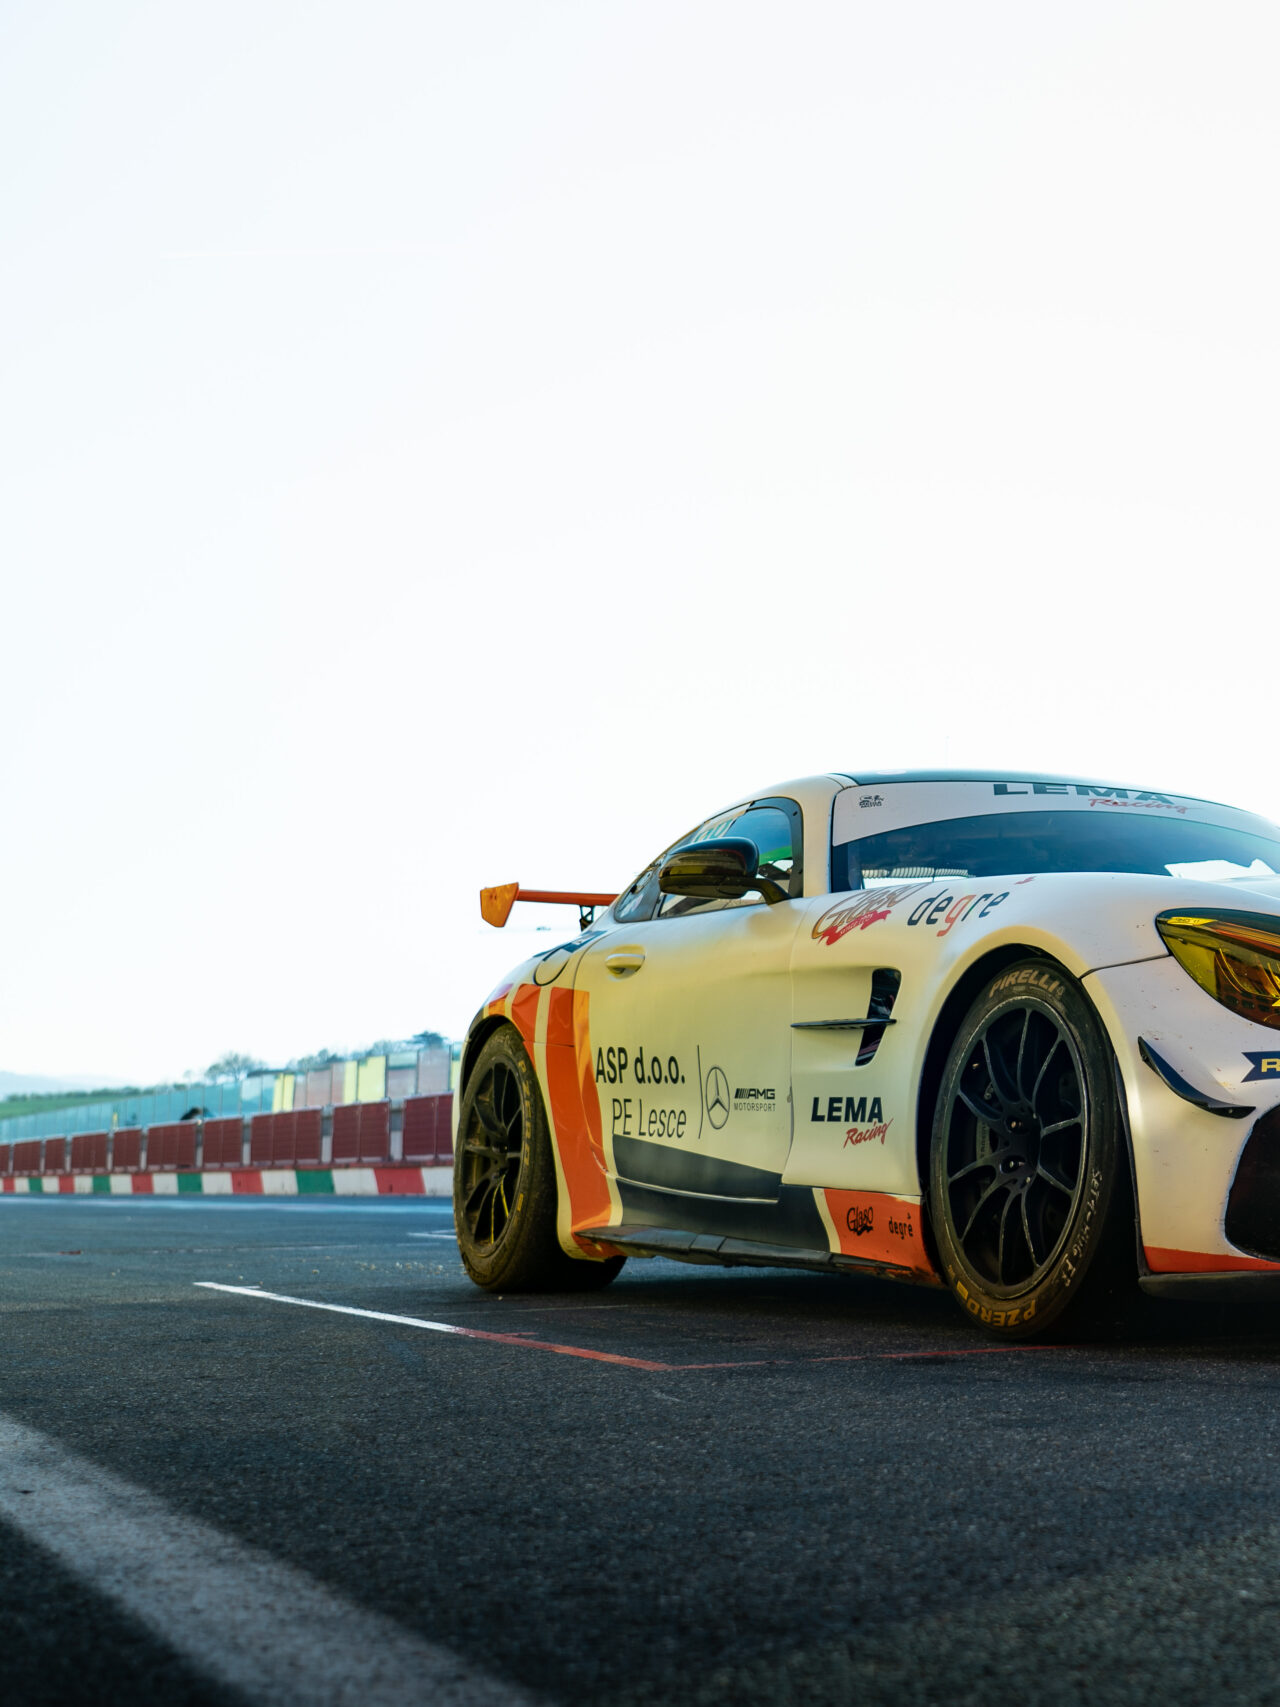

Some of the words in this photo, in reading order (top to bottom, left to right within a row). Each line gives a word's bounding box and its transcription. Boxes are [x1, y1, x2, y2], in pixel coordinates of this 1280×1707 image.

[993, 783, 1174, 805] LEMA
[1088, 797, 1189, 814] Racing
[988, 968, 1061, 999] PIRELLI
[596, 1046, 628, 1084] ASP
[634, 1046, 685, 1084] d.o.o.
[733, 1102, 776, 1112] MOTORSPORT
[746, 1088, 776, 1100] AMG
[612, 1098, 632, 1135] PE
[639, 1098, 687, 1138] Lesce
[811, 1097, 883, 1123] LEMA
[843, 1118, 894, 1149] Racing
